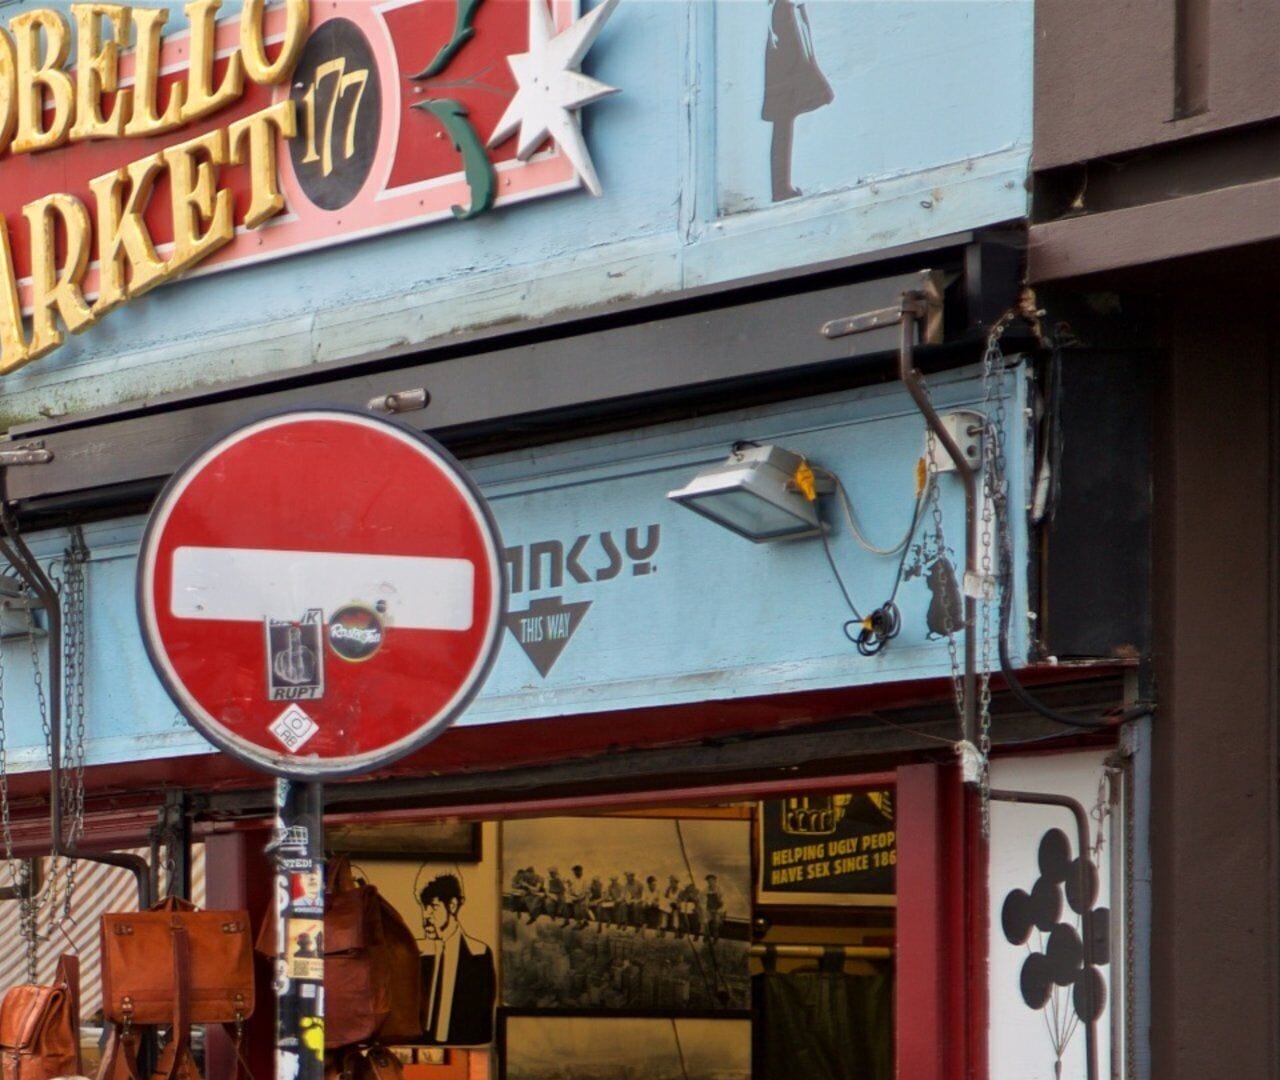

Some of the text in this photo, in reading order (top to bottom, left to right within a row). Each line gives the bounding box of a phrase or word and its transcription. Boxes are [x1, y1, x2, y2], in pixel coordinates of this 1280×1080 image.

[299, 57, 369, 179] 177
[503, 524, 661, 594] ANKSY
[520, 612, 571, 643] THIS WAY
[274, 686, 319, 699] RUPT
[771, 849, 897, 885] HAVE SEX SINCE 186
[772, 831, 896, 867] HELPING UGLY PEOP
